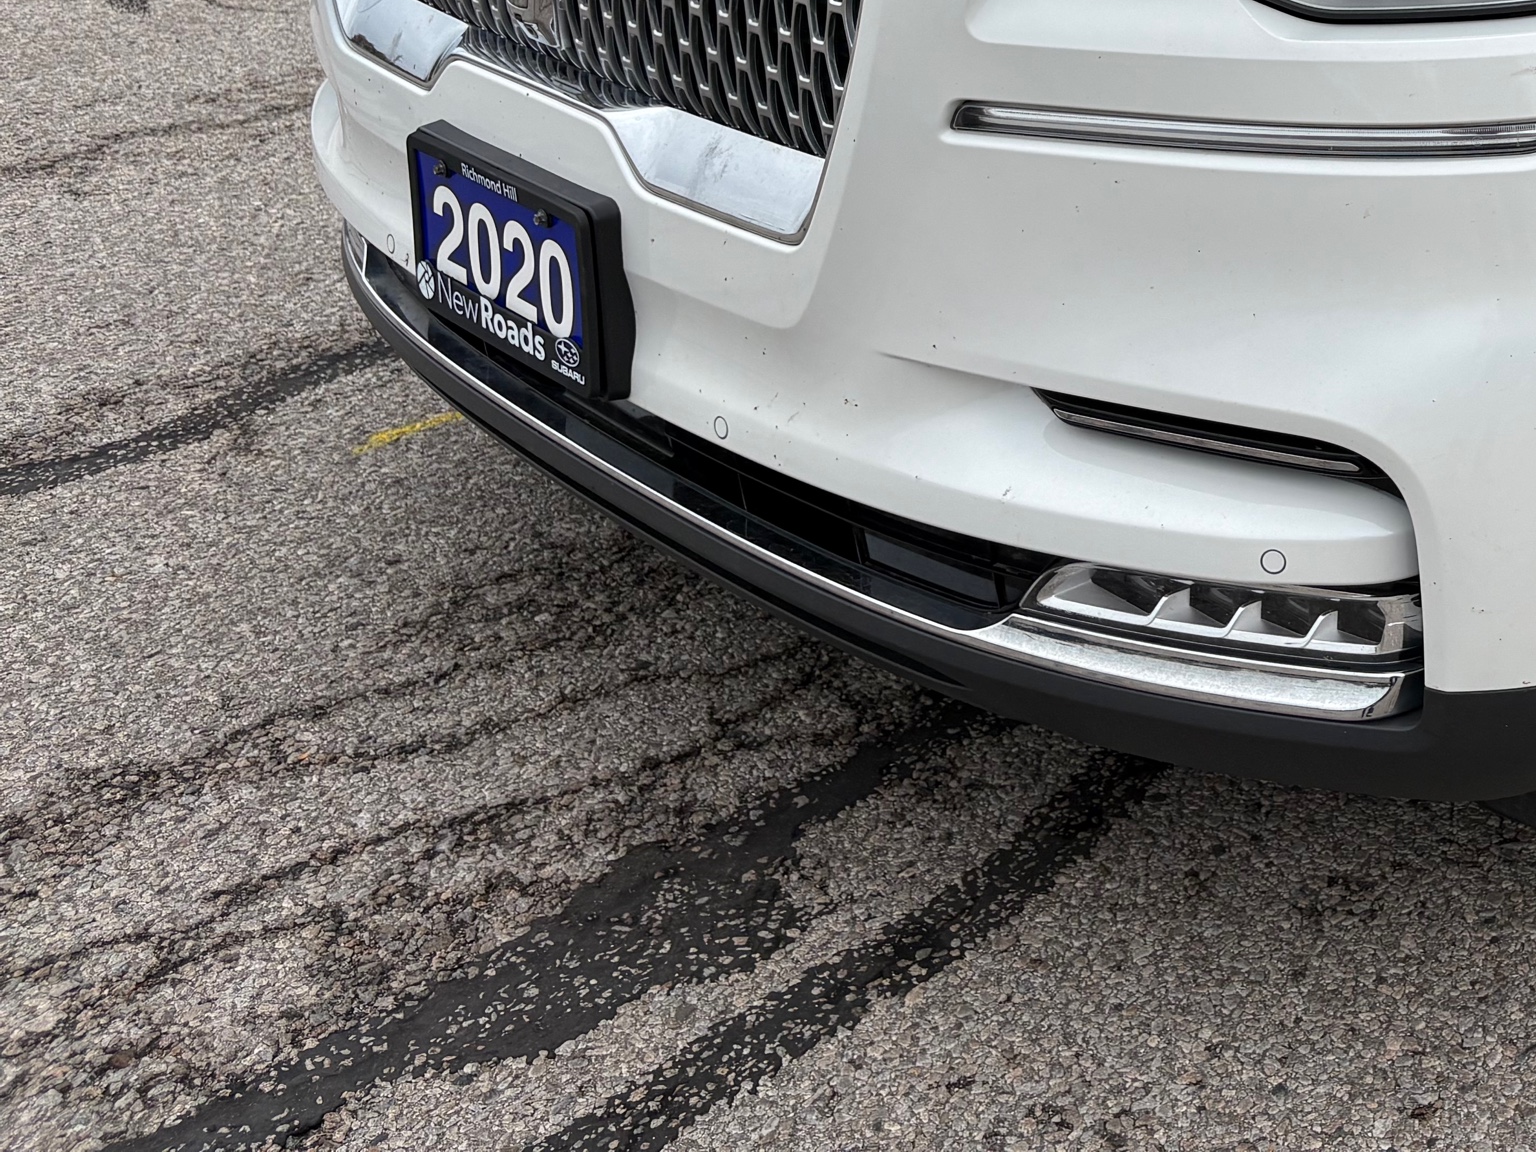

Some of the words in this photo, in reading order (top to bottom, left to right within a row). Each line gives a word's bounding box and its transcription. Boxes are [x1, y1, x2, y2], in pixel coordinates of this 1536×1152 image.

[460, 162, 502, 195] Richmond
[502, 182, 518, 202] Hill
[433, 185, 574, 338] 2020
[551, 359, 585, 385] SUBARU
